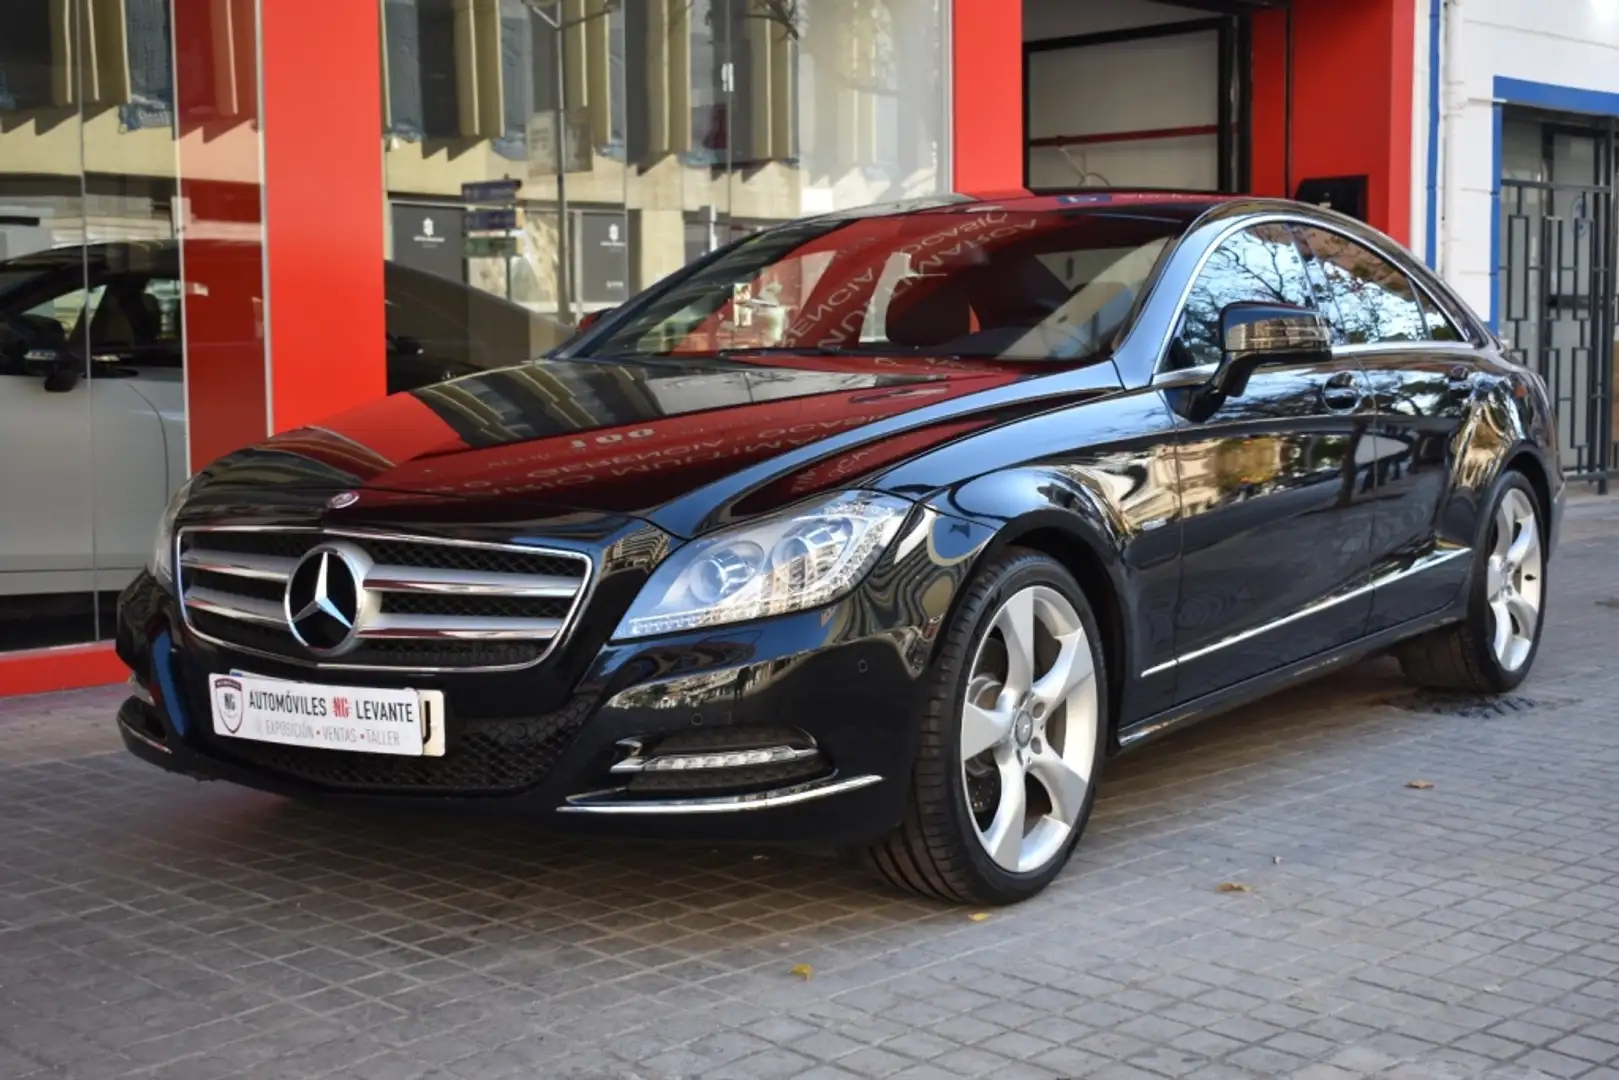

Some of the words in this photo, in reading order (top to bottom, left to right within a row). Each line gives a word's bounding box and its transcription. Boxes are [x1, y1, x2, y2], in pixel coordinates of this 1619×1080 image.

[249, 690, 327, 717] AUTOMÓVILES
[331, 696, 352, 717] NG
[355, 701, 414, 722] LEVANTE
[265, 719, 315, 739] EXPOSICIÓN
[323, 728, 357, 744] VENTAS
[365, 728, 401, 747] TALLER
